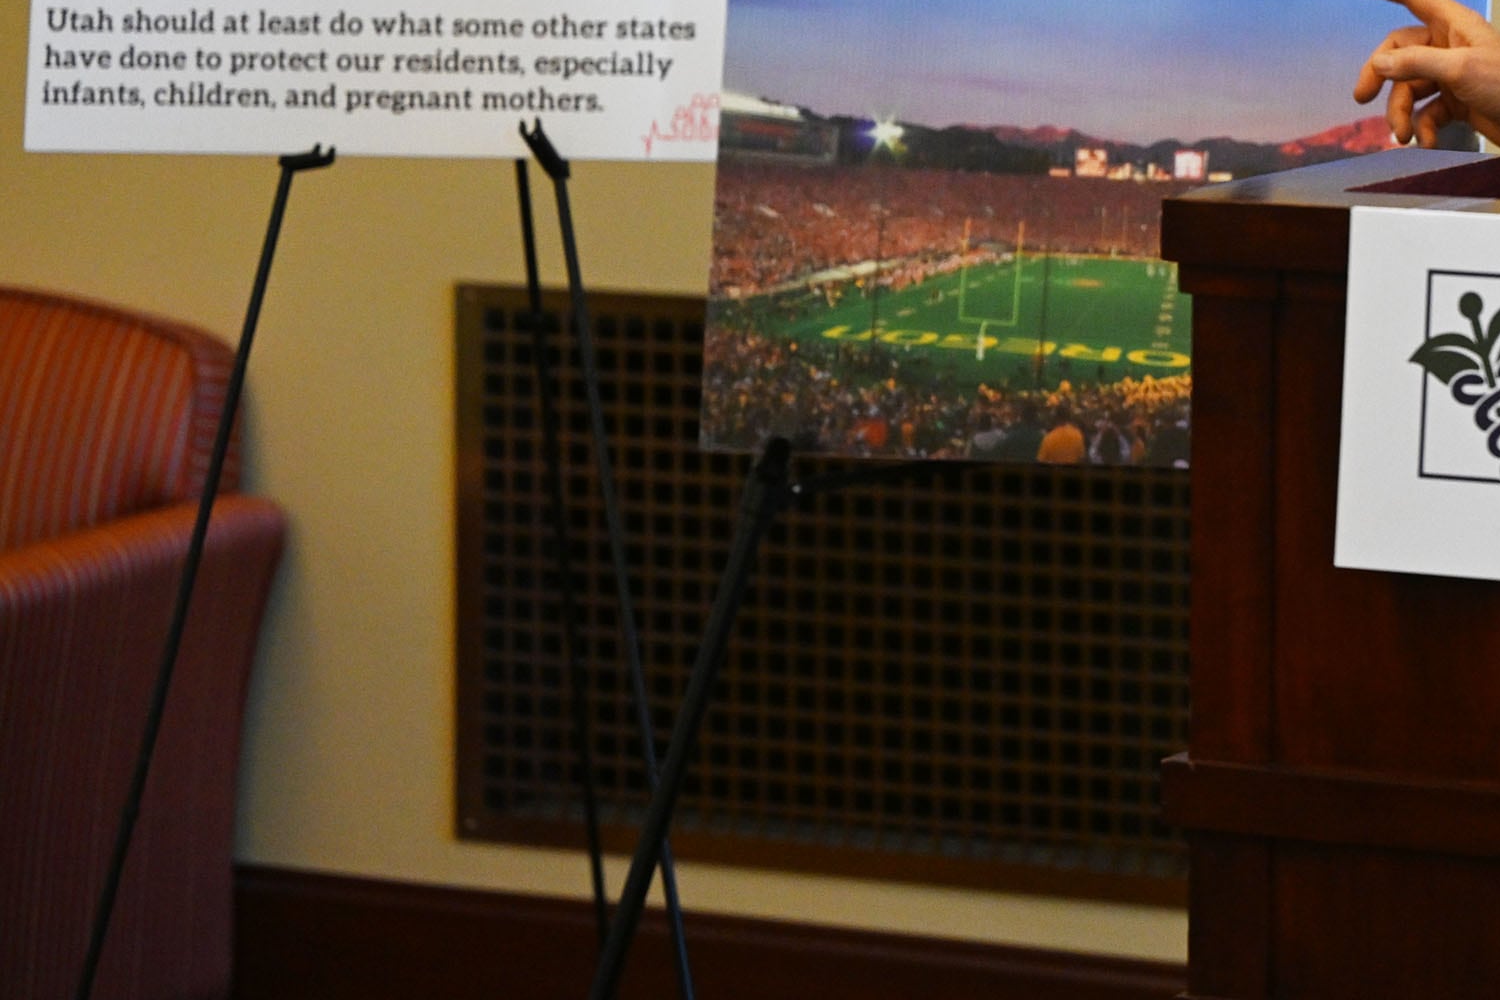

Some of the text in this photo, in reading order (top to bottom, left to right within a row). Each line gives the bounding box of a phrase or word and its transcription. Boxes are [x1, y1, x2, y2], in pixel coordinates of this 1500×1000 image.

[47, 7, 696, 41] Utah should at least do what some other states
[44, 43, 673, 81] have done to protect our residents, especially
[42, 80, 603, 115] infants, children, and pregnant mothers.
